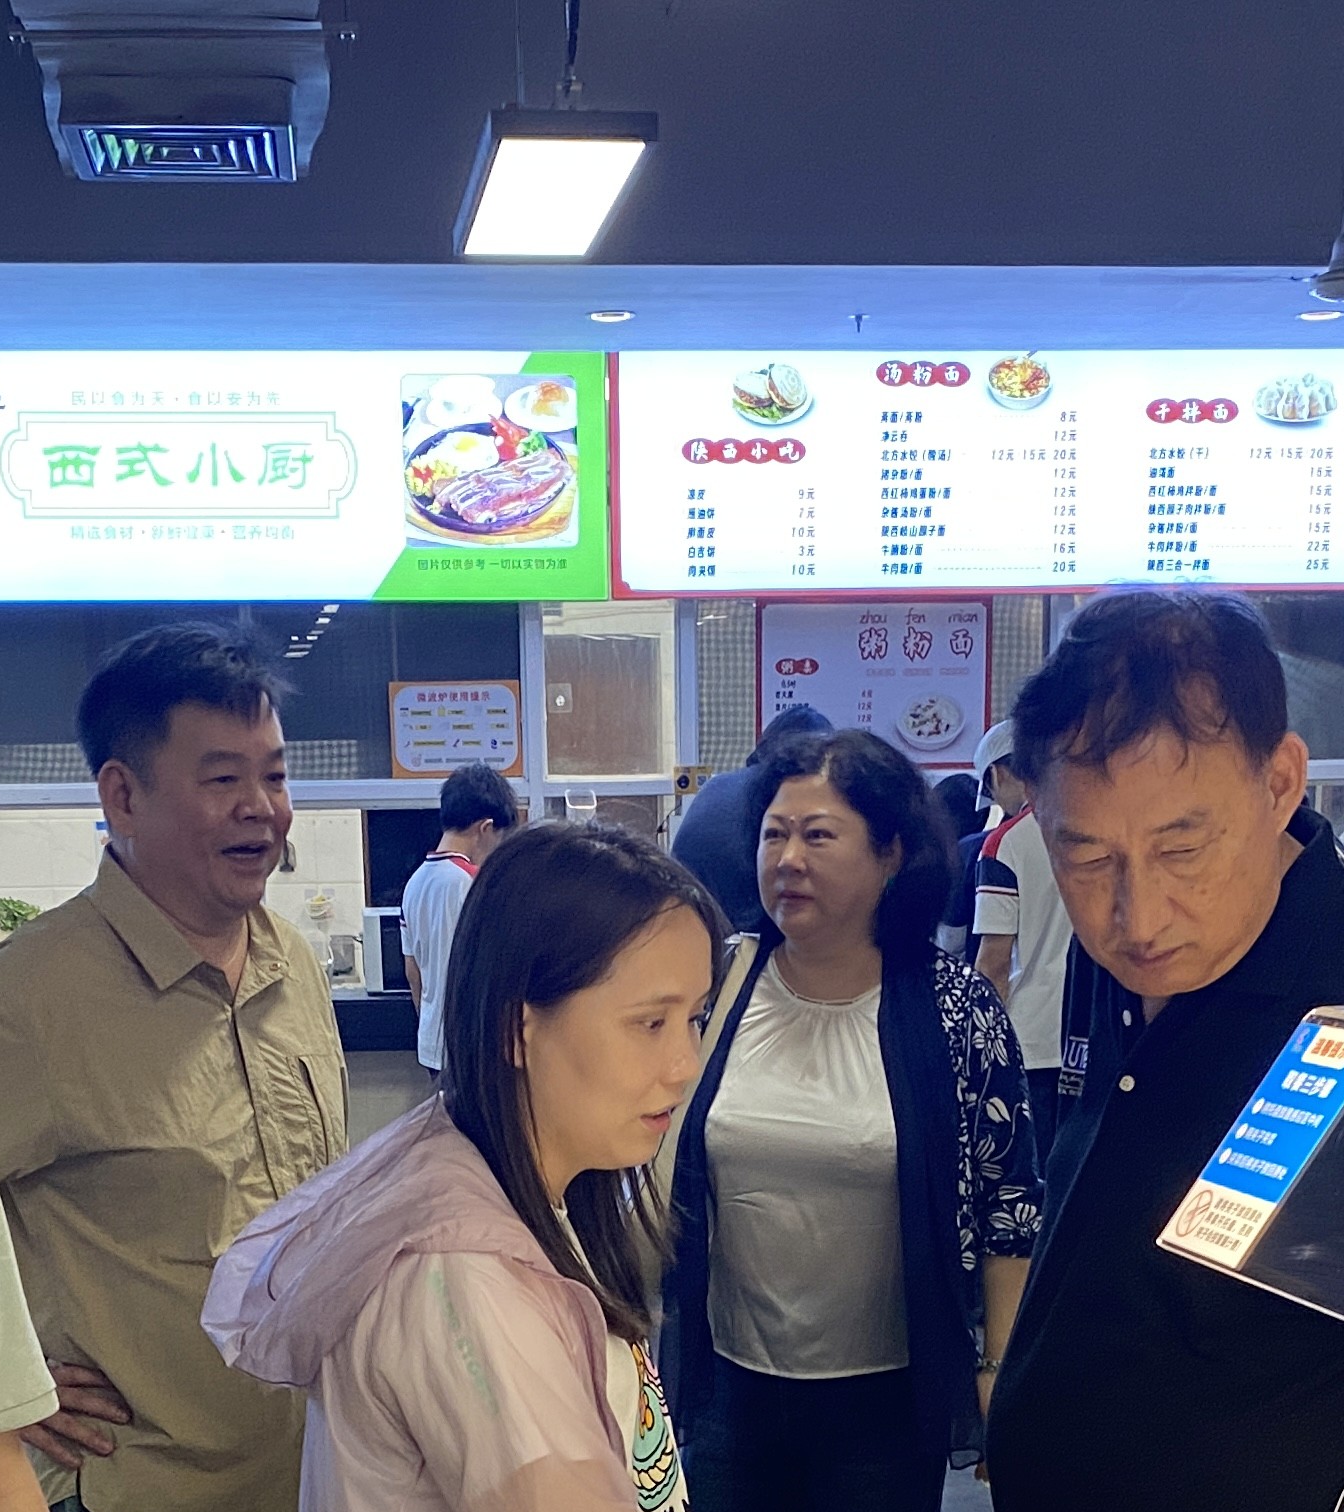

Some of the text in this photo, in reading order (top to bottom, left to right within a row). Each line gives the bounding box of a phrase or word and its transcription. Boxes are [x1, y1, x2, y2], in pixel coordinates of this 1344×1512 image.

[883, 363, 960, 384] 汤粉面
[1060, 411, 1077, 422] 8元
[1154, 402, 1230, 421] 干拌面
[1055, 430, 1077, 441] 12元
[689, 441, 800, 461] 陕西小吃
[992, 449, 1014, 461] 12元
[1024, 449, 1046, 460] 15元
[1053, 448, 1076, 460] 20元
[1250, 447, 1272, 459] 12元
[1281, 447, 1303, 459] 15元
[1310, 447, 1333, 459] 20元
[40, 441, 314, 491] 西式小厨
[1311, 466, 1332, 477] 15元
[1055, 468, 1076, 479] 12元
[799, 488, 815, 500] 9元
[1054, 487, 1076, 497] 12元
[1310, 484, 1332, 496] 15元
[799, 507, 815, 519] 7元
[1054, 505, 1076, 516] 12元
[1309, 503, 1331, 515] 15元
[792, 526, 815, 537] 10元
[1054, 523, 1076, 535] 12元
[1309, 522, 1330, 533] 15元
[799, 545, 815, 556] 3元
[1054, 543, 1075, 554] 16元
[1307, 540, 1330, 552] 22元
[417, 557, 568, 571] 图片仅供参考 一切以实物为准
[792, 564, 815, 576] 10元
[1052, 561, 1076, 572] 20元
[1306, 558, 1329, 570] 25元
[859, 607, 979, 625] zhou fen mian
[858, 626, 974, 661] 粥粉面
